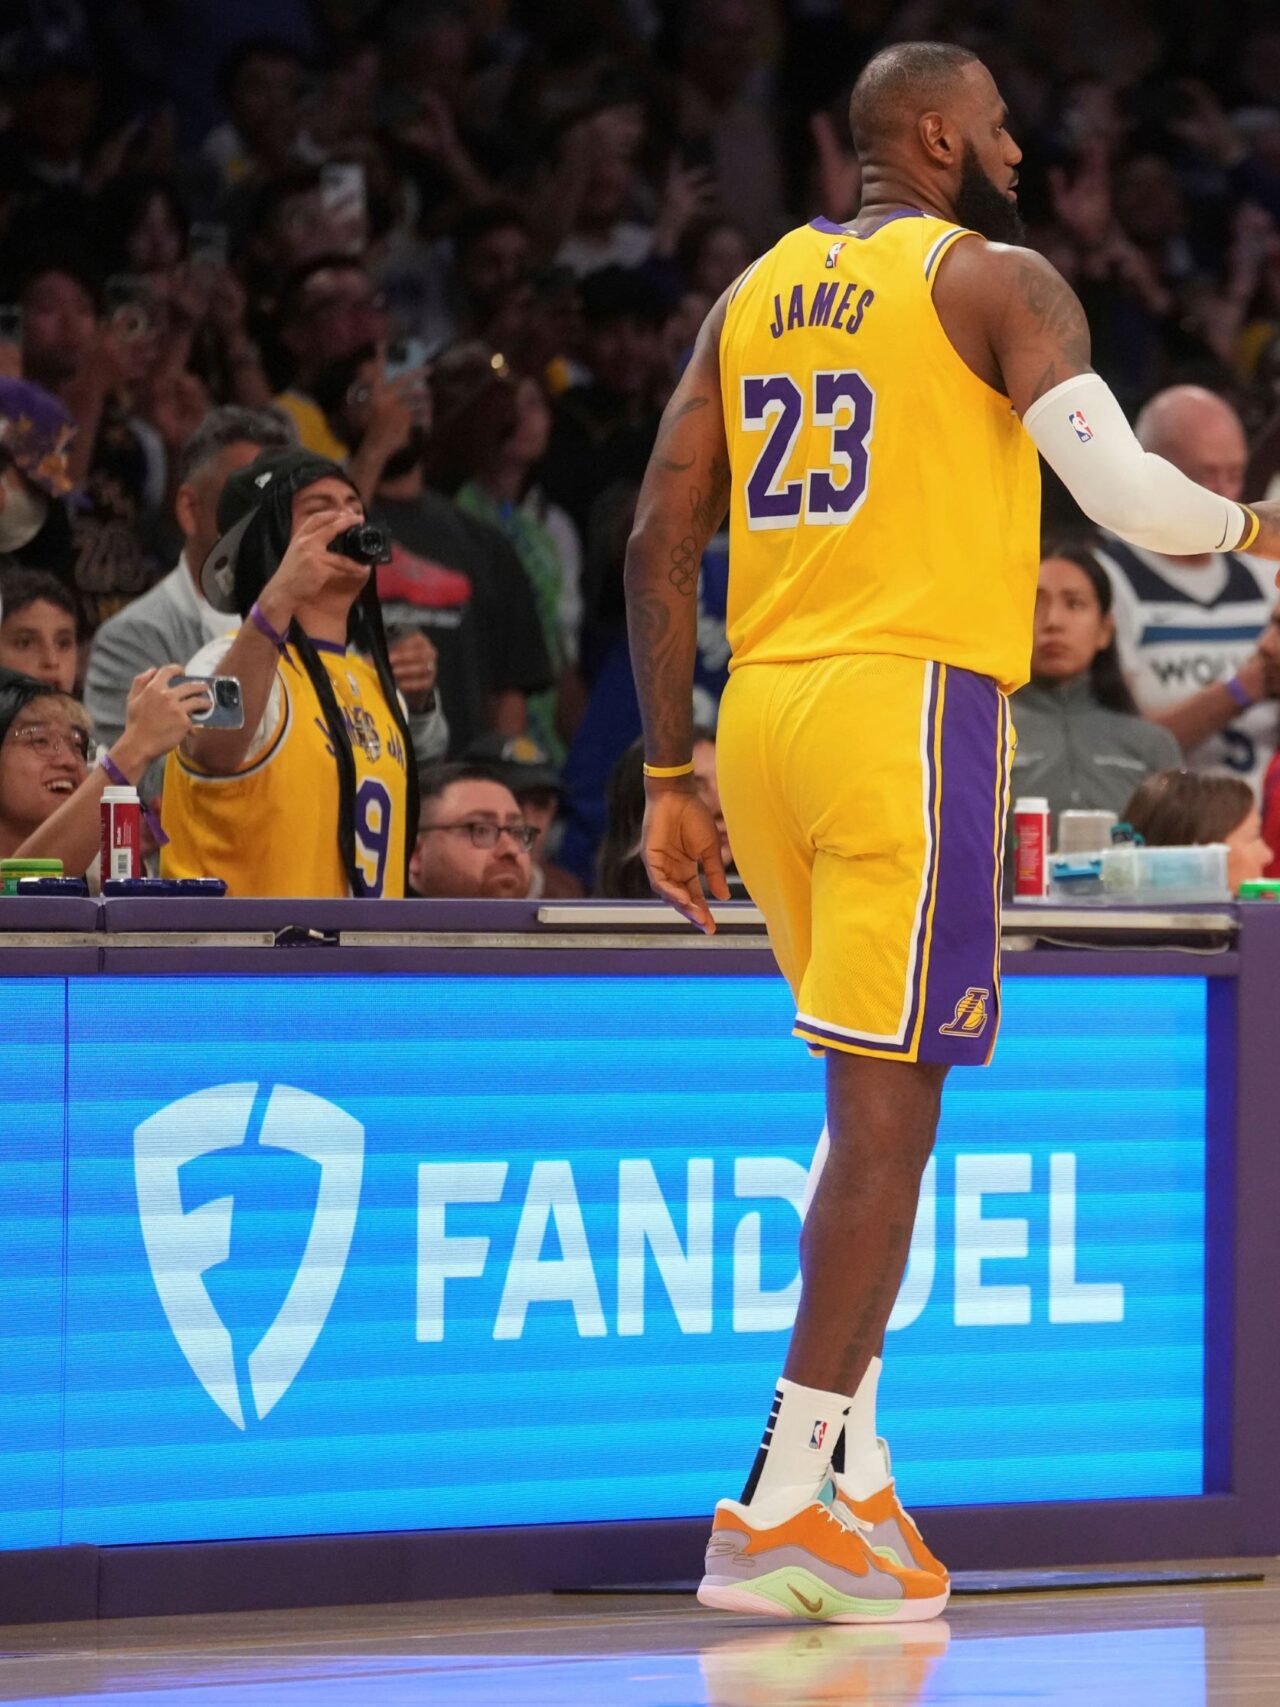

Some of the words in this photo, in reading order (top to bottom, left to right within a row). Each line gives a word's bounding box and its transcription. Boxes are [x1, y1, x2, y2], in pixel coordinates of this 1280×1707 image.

[769, 281, 875, 340] JAMES
[740, 368, 877, 532] 23
[354, 775, 392, 899] 9
